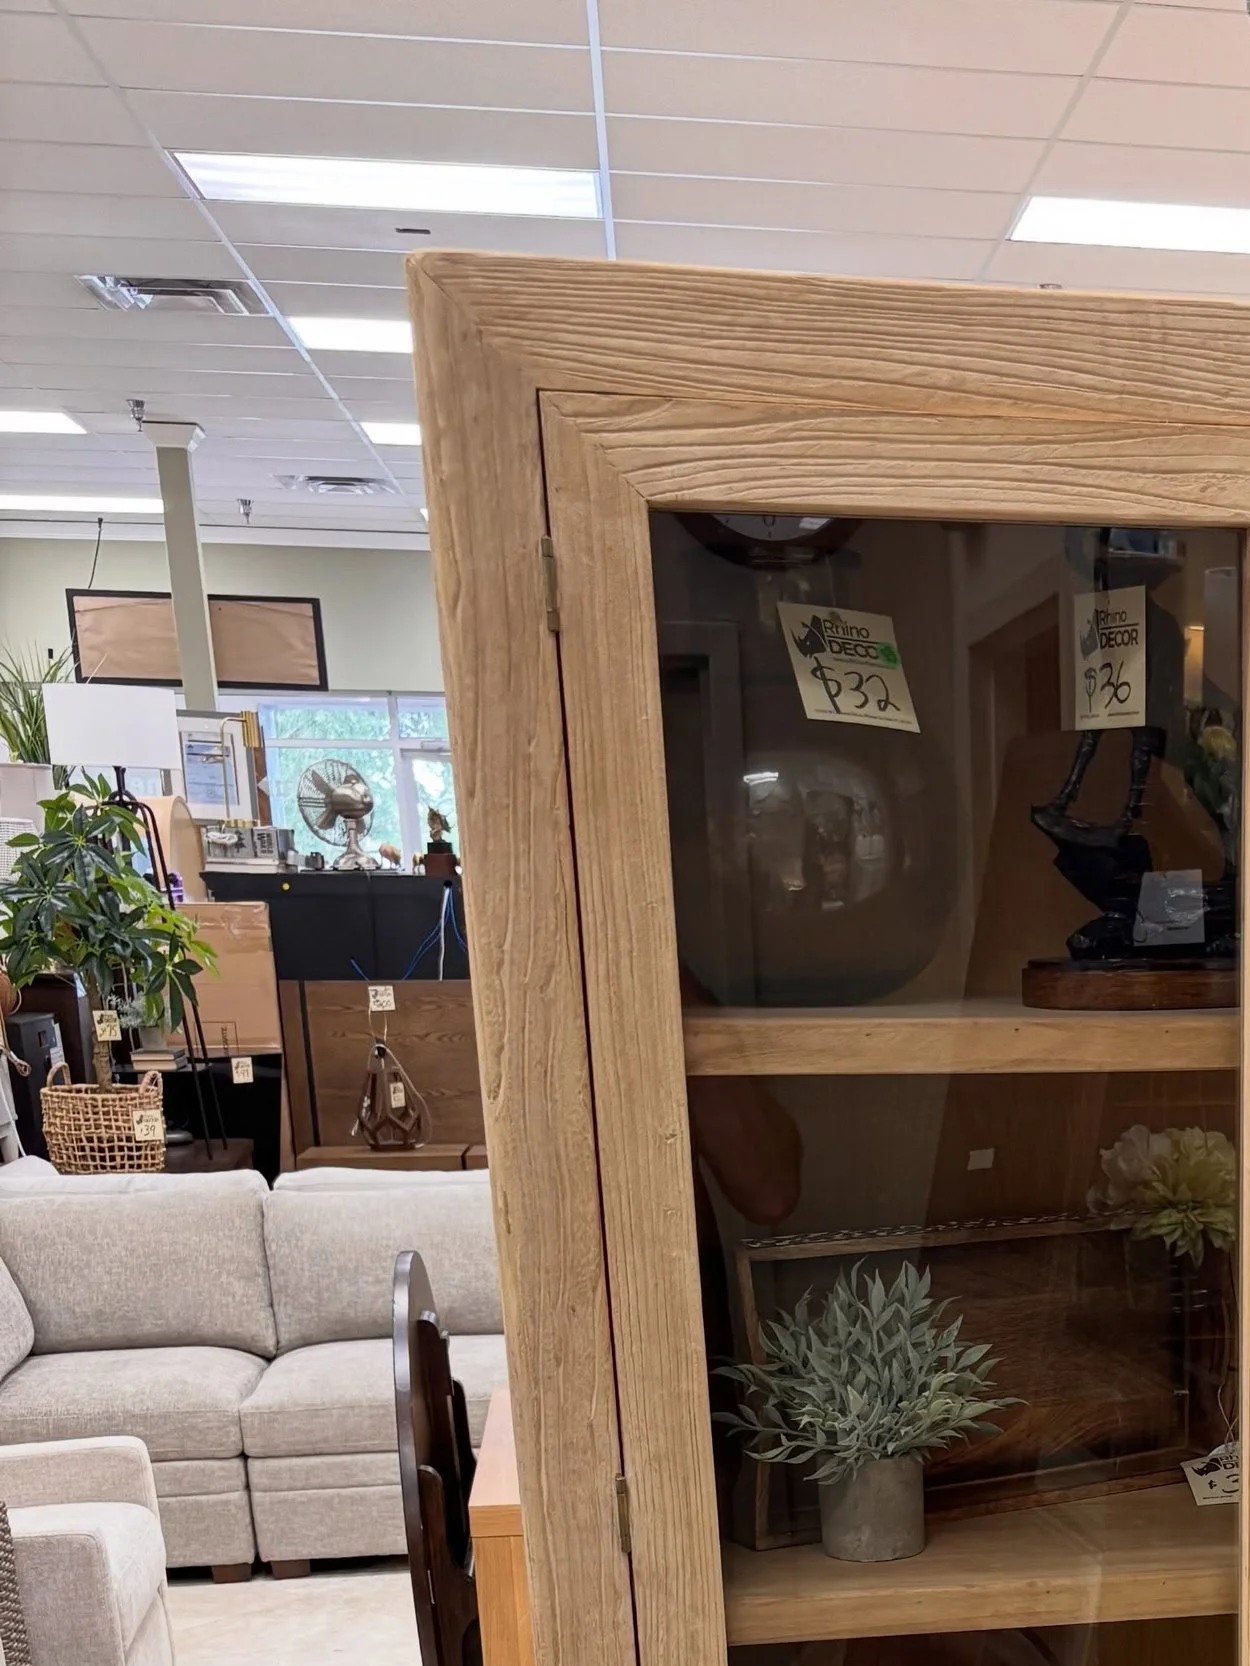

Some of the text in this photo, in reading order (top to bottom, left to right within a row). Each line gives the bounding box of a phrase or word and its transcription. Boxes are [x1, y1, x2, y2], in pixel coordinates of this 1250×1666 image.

[823, 619, 870, 639] Rhino
[1100, 628, 1139, 649] DECOR
[827, 639, 888, 662] DECO
[810, 656, 901, 714] $32
